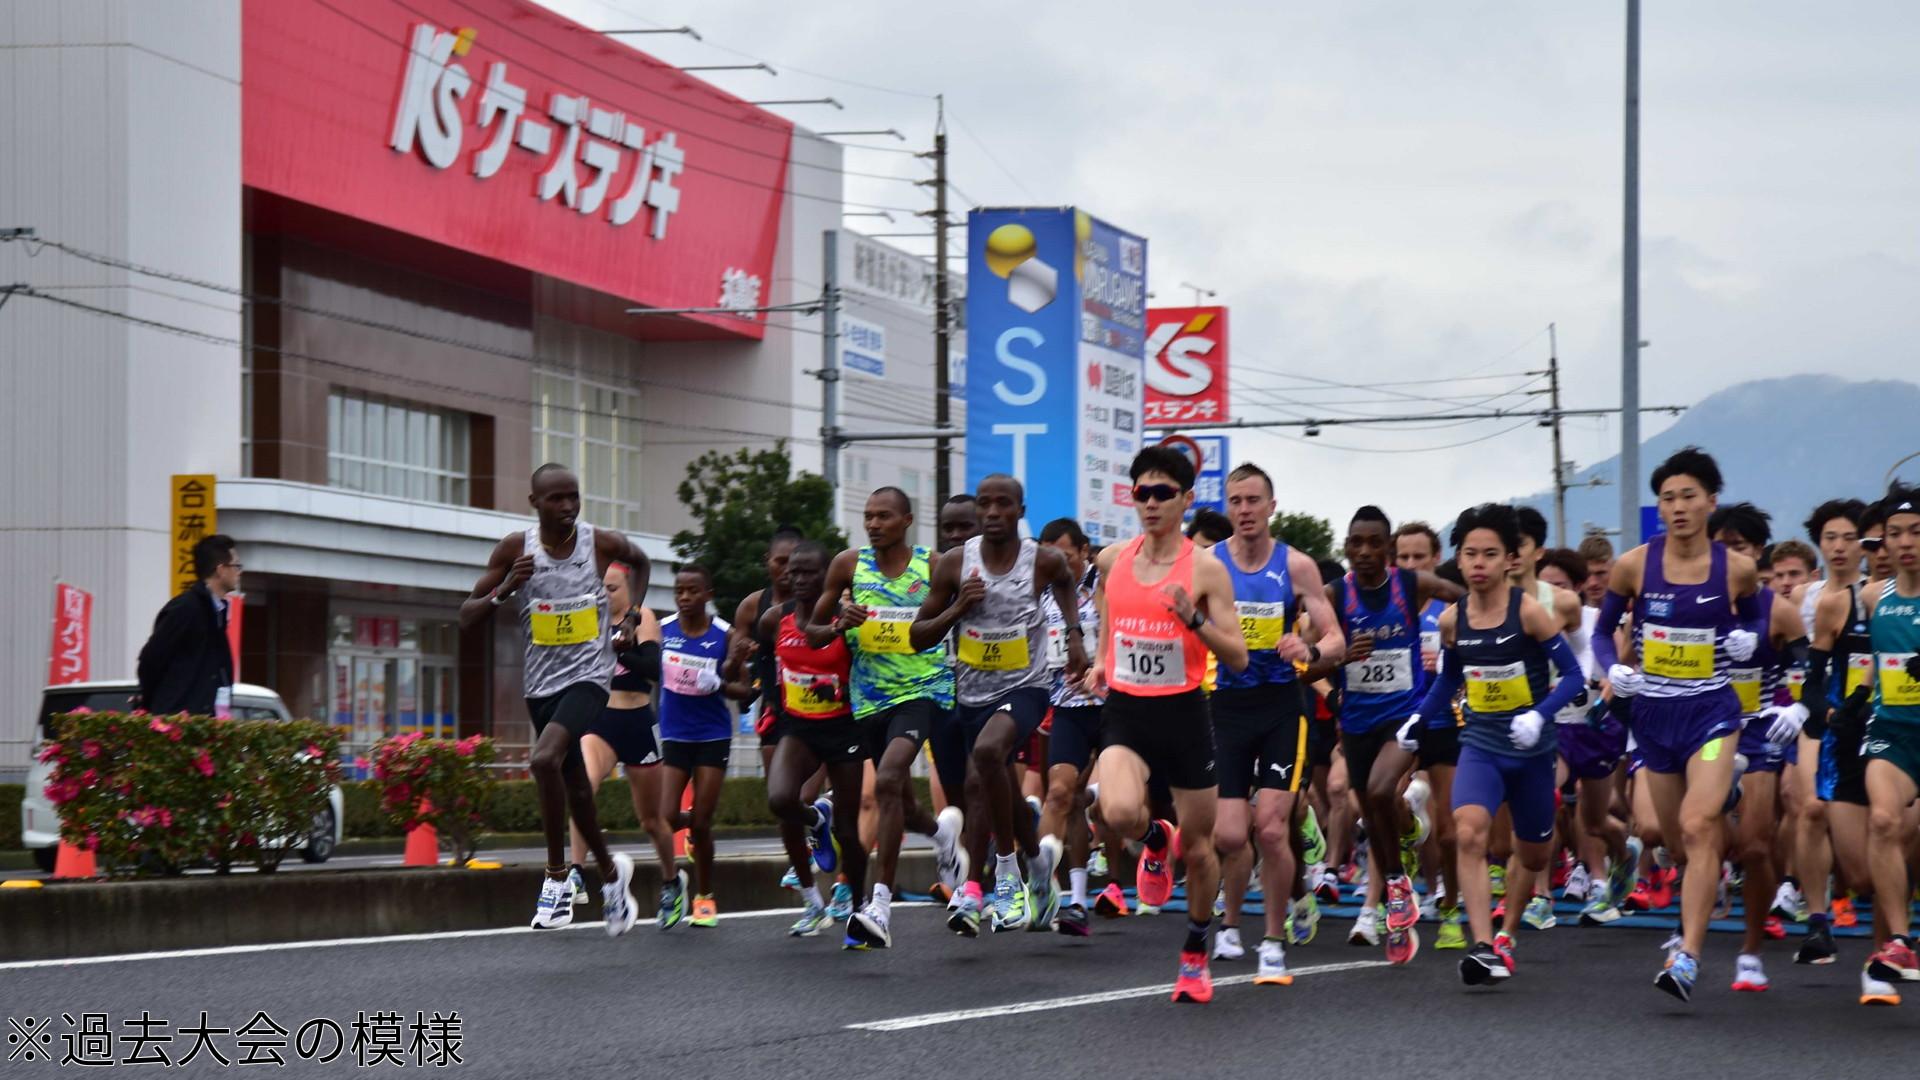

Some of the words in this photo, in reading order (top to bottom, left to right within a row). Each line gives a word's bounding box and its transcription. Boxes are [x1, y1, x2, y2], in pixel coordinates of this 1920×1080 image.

[474, 62, 686, 240] ケーズデンキ
[992, 327, 1048, 541] ST
[555, 614, 572, 627] 75
[1241, 618, 1256, 632] 52
[879, 624, 895, 637] 54
[983, 642, 1000, 655] 76
[1669, 645, 1685, 658] 71
[1128, 653, 1166, 676] 105
[1361, 664, 1395, 683] 283
